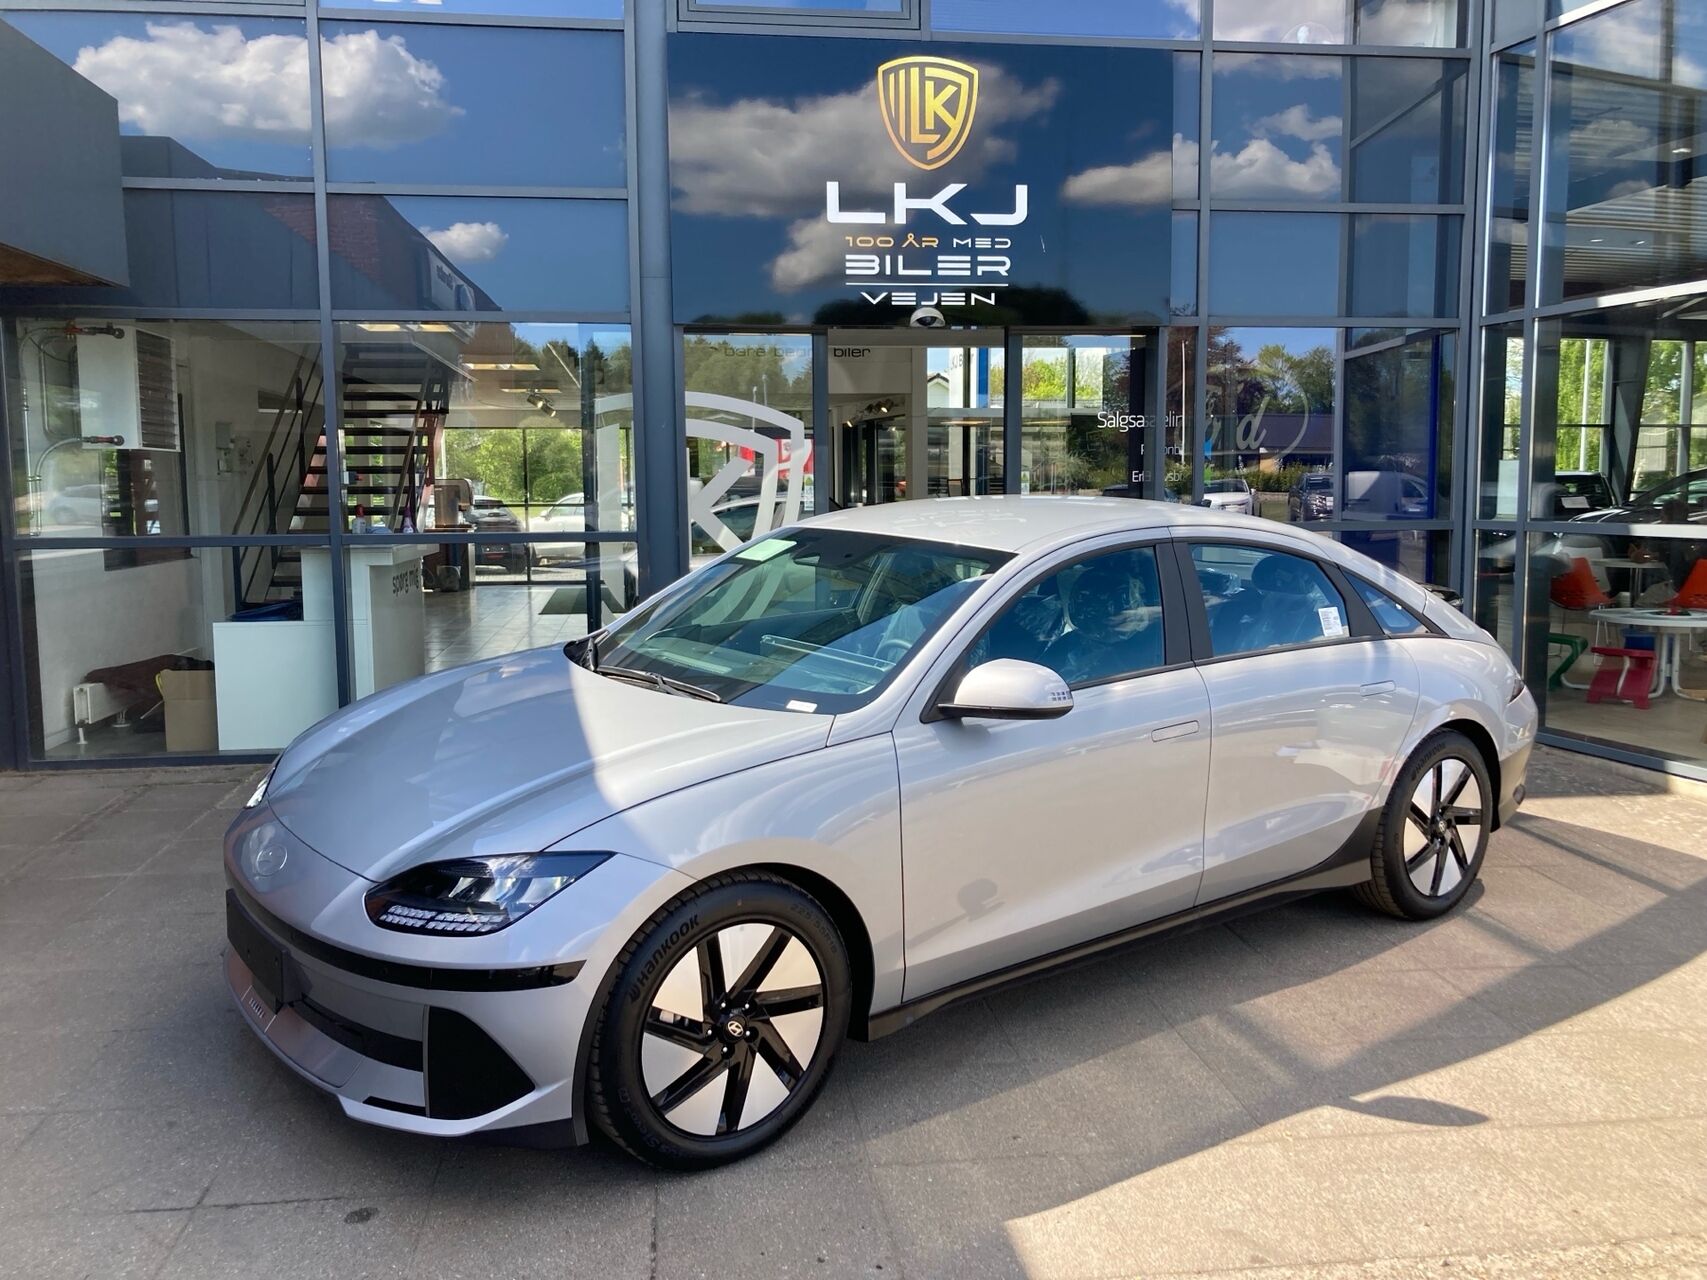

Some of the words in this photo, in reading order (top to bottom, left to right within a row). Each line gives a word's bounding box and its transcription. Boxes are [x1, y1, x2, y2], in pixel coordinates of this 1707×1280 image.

[826, 181, 1028, 226] LKJ
[845, 236, 895, 248] 100
[902, 232, 939, 248] ÅR
[953, 237, 1011, 249] MED
[845, 254, 1011, 276] BILER
[861, 291, 995, 306] VEJEN
[833, 346, 871, 358] biler
